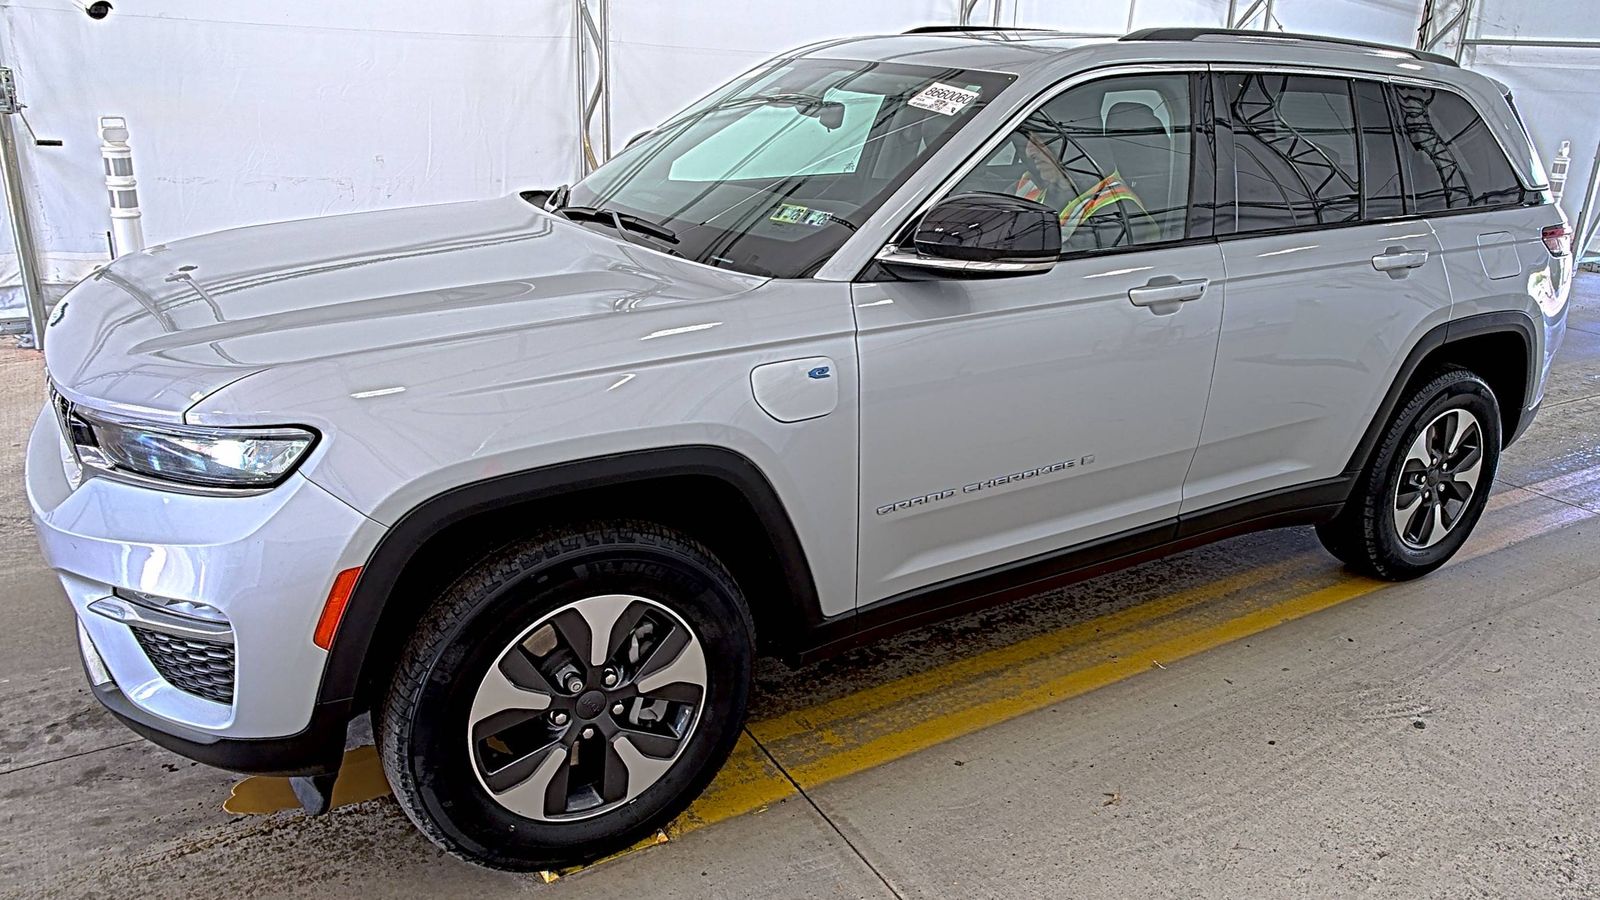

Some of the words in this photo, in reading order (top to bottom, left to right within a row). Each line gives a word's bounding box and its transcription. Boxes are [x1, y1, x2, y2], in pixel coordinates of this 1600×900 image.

[924, 87, 974, 105] 8660060
[876, 488, 957, 515] GRAND
[963, 459, 1076, 494] CHEROKEE
